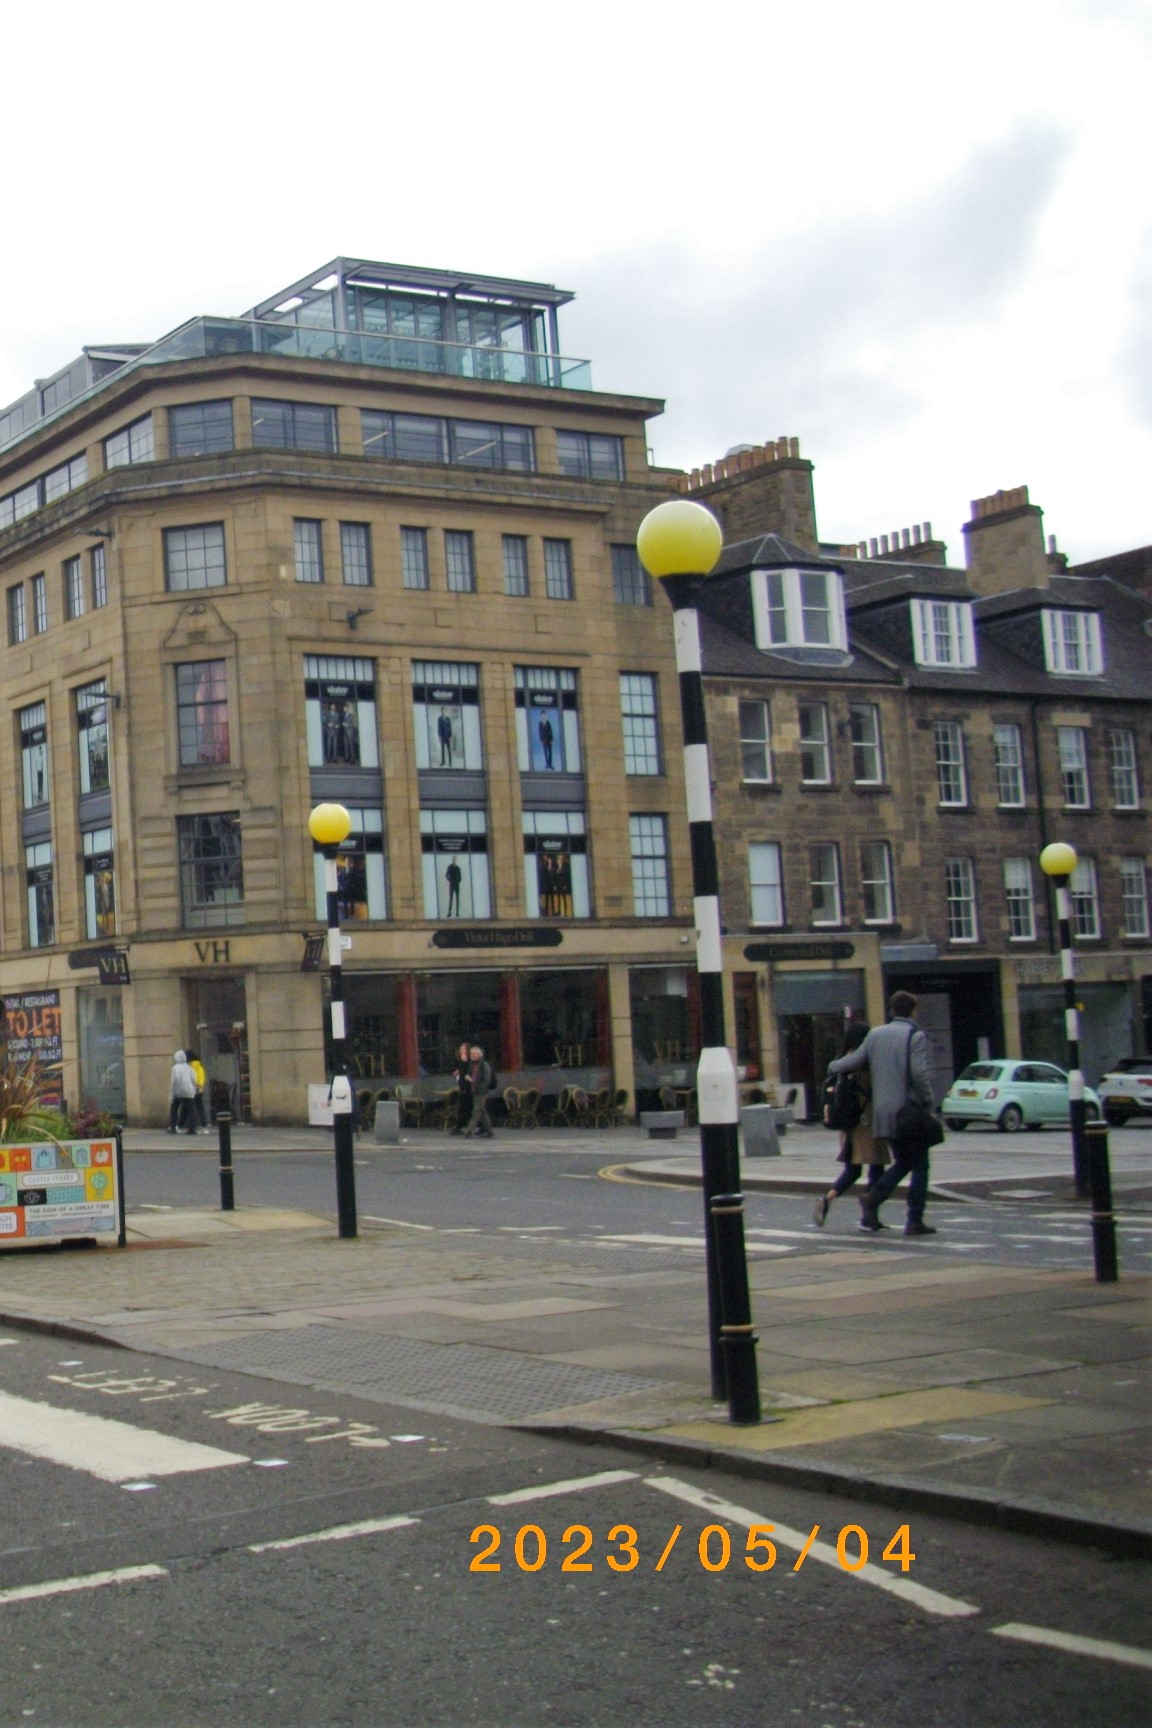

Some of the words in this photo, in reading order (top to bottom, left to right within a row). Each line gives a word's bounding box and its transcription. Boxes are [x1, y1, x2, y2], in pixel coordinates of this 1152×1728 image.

[464, 931, 488, 943] Victor
[194, 940, 231, 964] VH
[100, 957, 126, 974] VH
[24, 994, 56, 1007] RESTAURANT
[6, 1011, 28, 1038] TO
[32, 1007, 62, 1037] LET
[553, 1045, 583, 1066] VH
[654, 1040, 681, 1061] VH
[354, 1053, 386, 1077] VH
